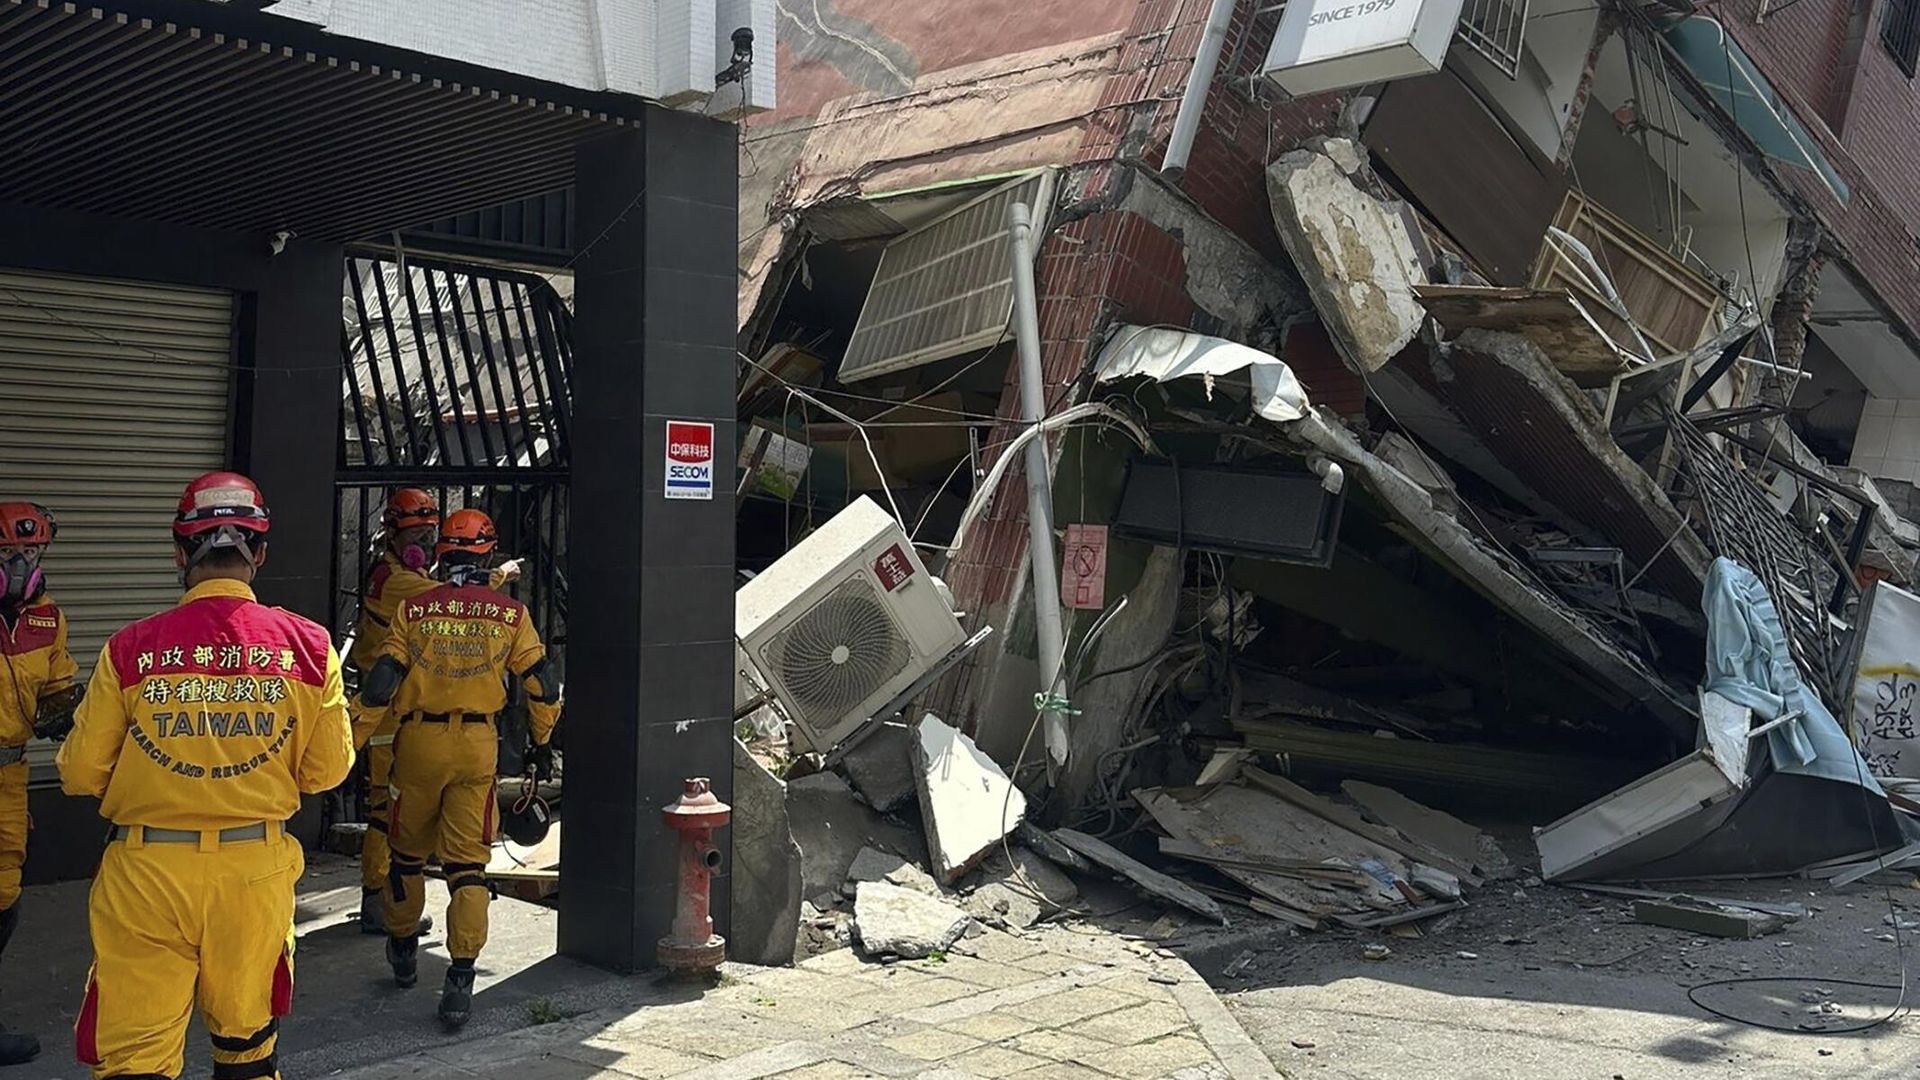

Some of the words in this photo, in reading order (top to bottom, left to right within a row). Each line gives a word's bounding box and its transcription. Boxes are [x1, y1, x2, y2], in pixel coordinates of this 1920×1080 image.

[1308, 6, 1355, 26] SINCE
[1357, 0, 1396, 16] 1979
[670, 442, 709, 458] 中保科技
[670, 465, 709, 479] SECOM
[136, 644, 297, 674] 內政部消防署
[143, 677, 287, 704] 特種搜救隊
[152, 711, 275, 738] TAIWAN
[171, 760, 205, 779] AND
[211, 752, 269, 779] RESCUE
